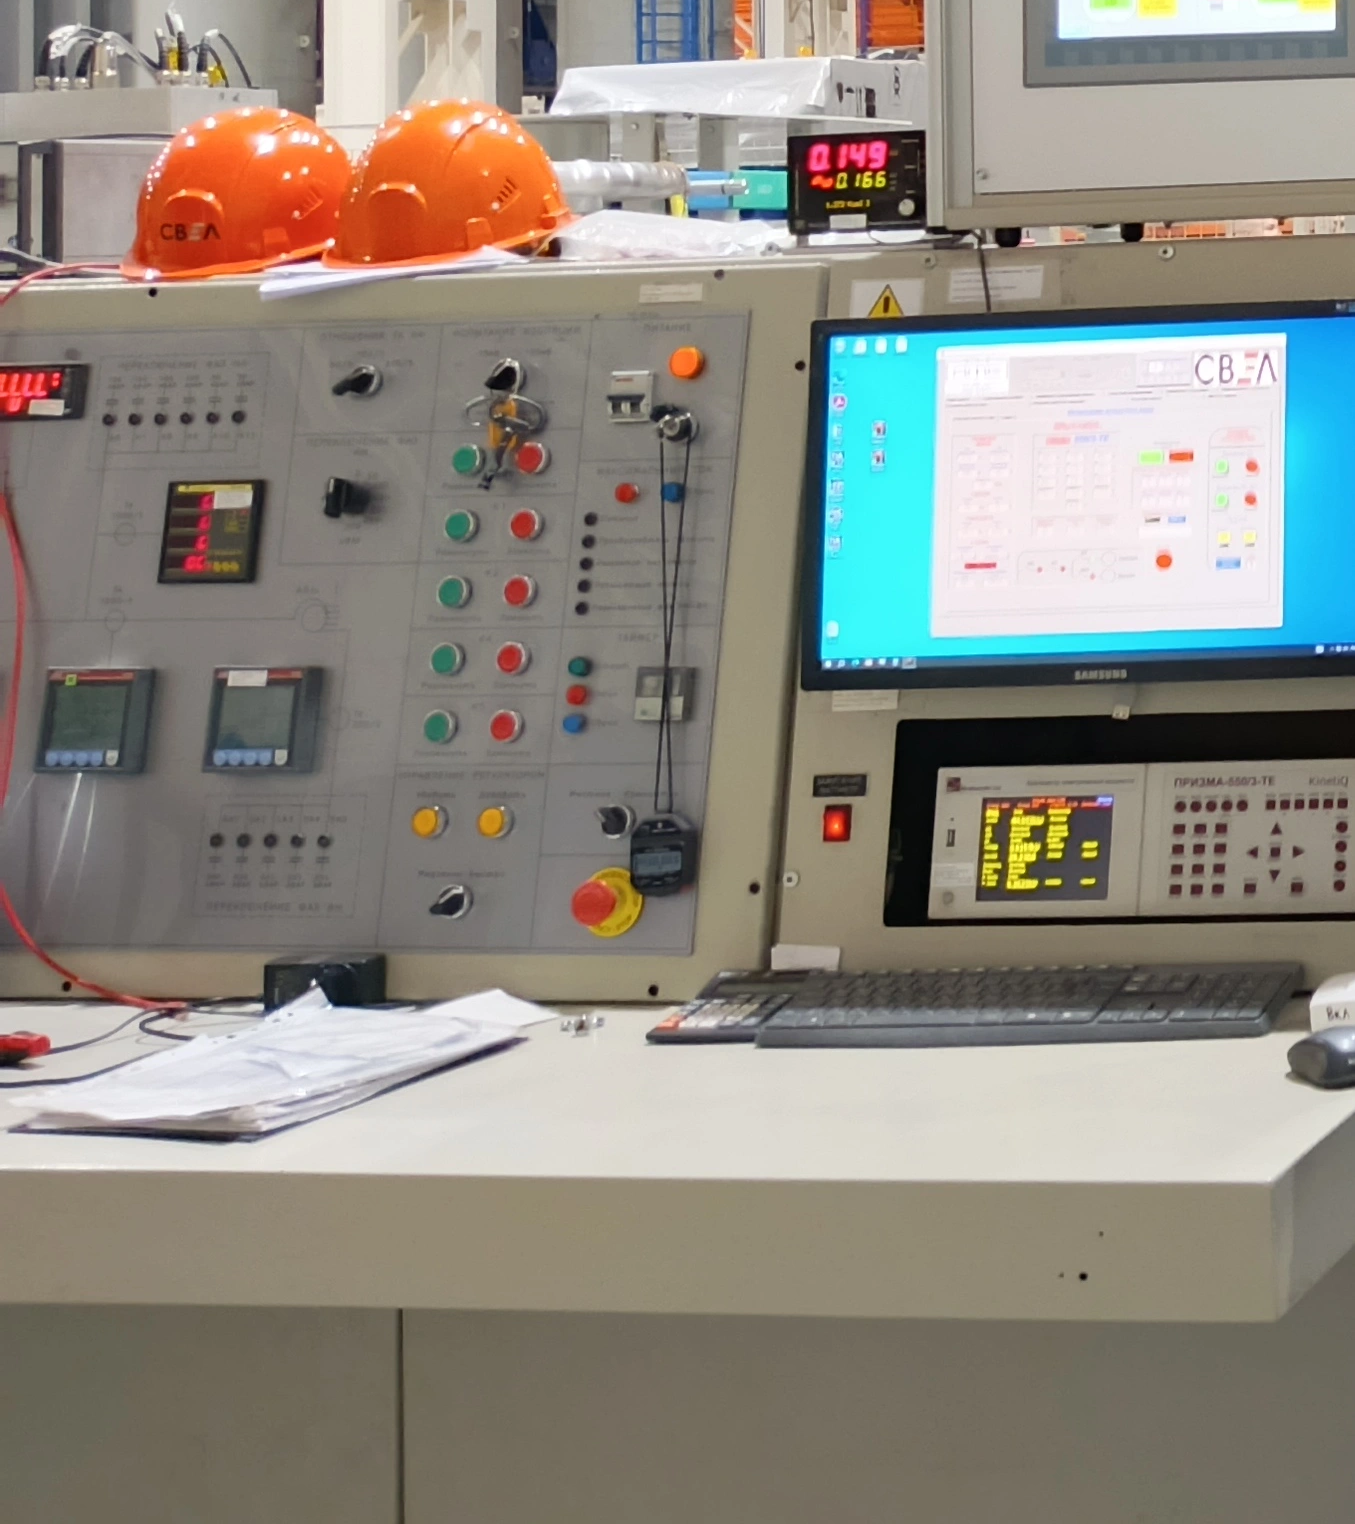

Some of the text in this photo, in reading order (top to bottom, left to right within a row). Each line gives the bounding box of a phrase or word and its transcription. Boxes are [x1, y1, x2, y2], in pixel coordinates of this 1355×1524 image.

[807, 140, 889, 172] 0.149
[835, 170, 887, 190] 0.166
[1074, 668, 1128, 681] SAMSUNG
